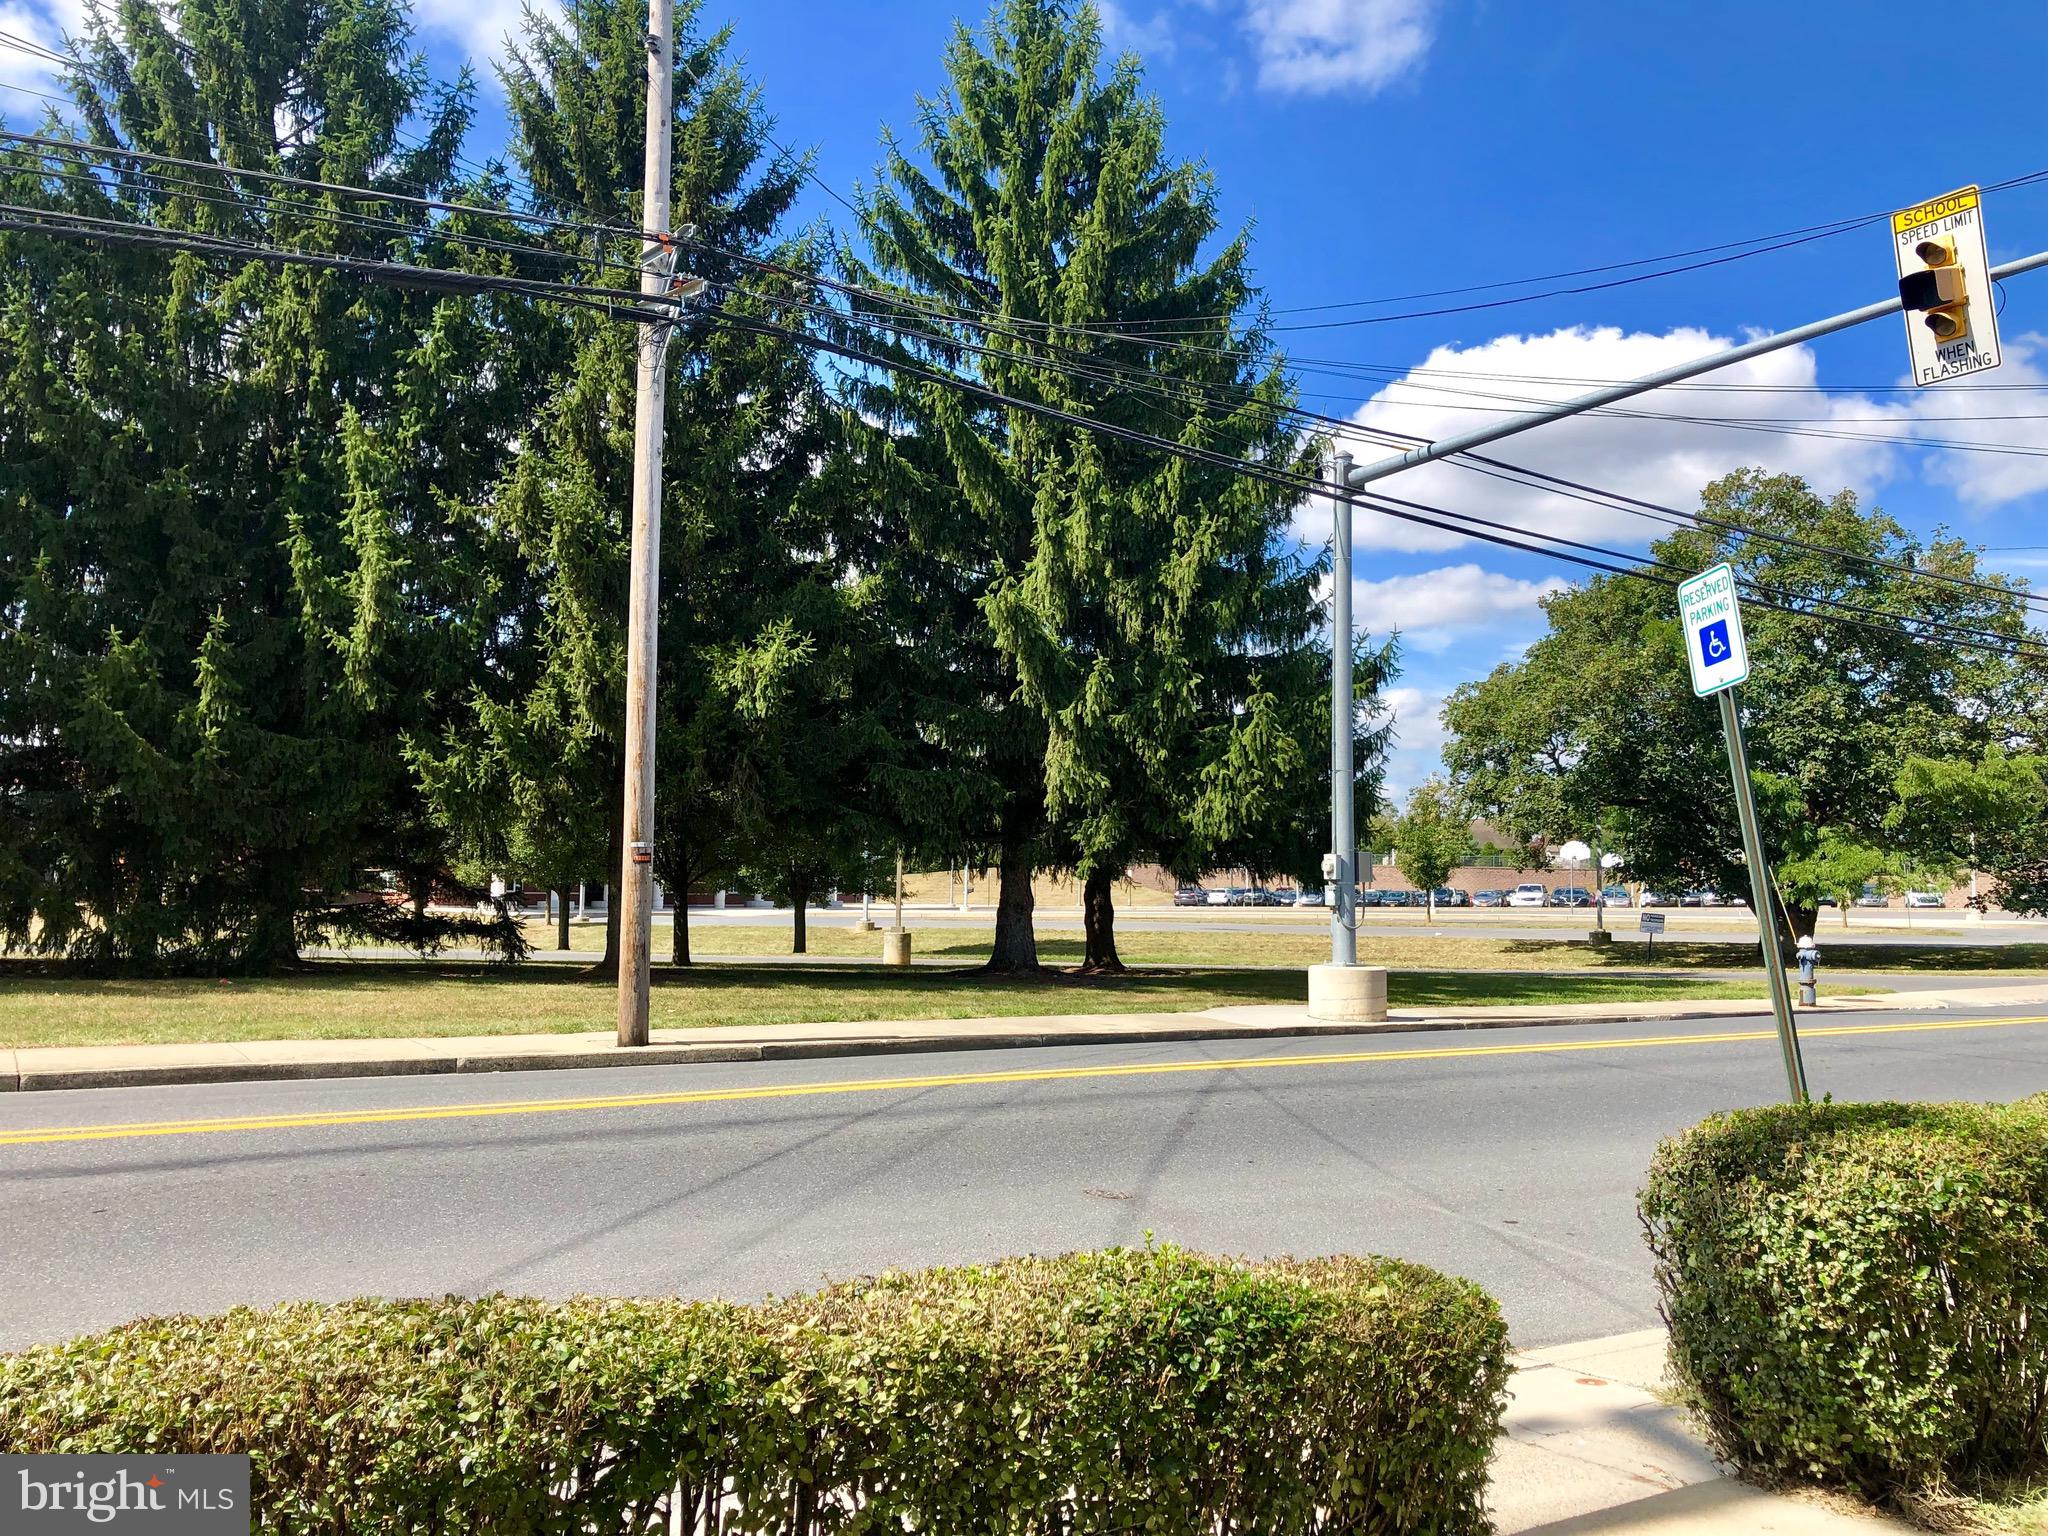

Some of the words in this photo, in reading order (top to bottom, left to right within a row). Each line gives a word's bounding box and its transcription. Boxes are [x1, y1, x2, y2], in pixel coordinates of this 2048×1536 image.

[1903, 198, 1968, 226] SCHOOL
[1901, 222, 1939, 246] SPEED
[1944, 210, 1973, 232] LIMIT
[1935, 340, 1975, 363] WHEN
[1923, 352, 1993, 382] FLASHING
[1683, 576, 1729, 608] RESERVED
[1690, 597, 1730, 626] PARKING
